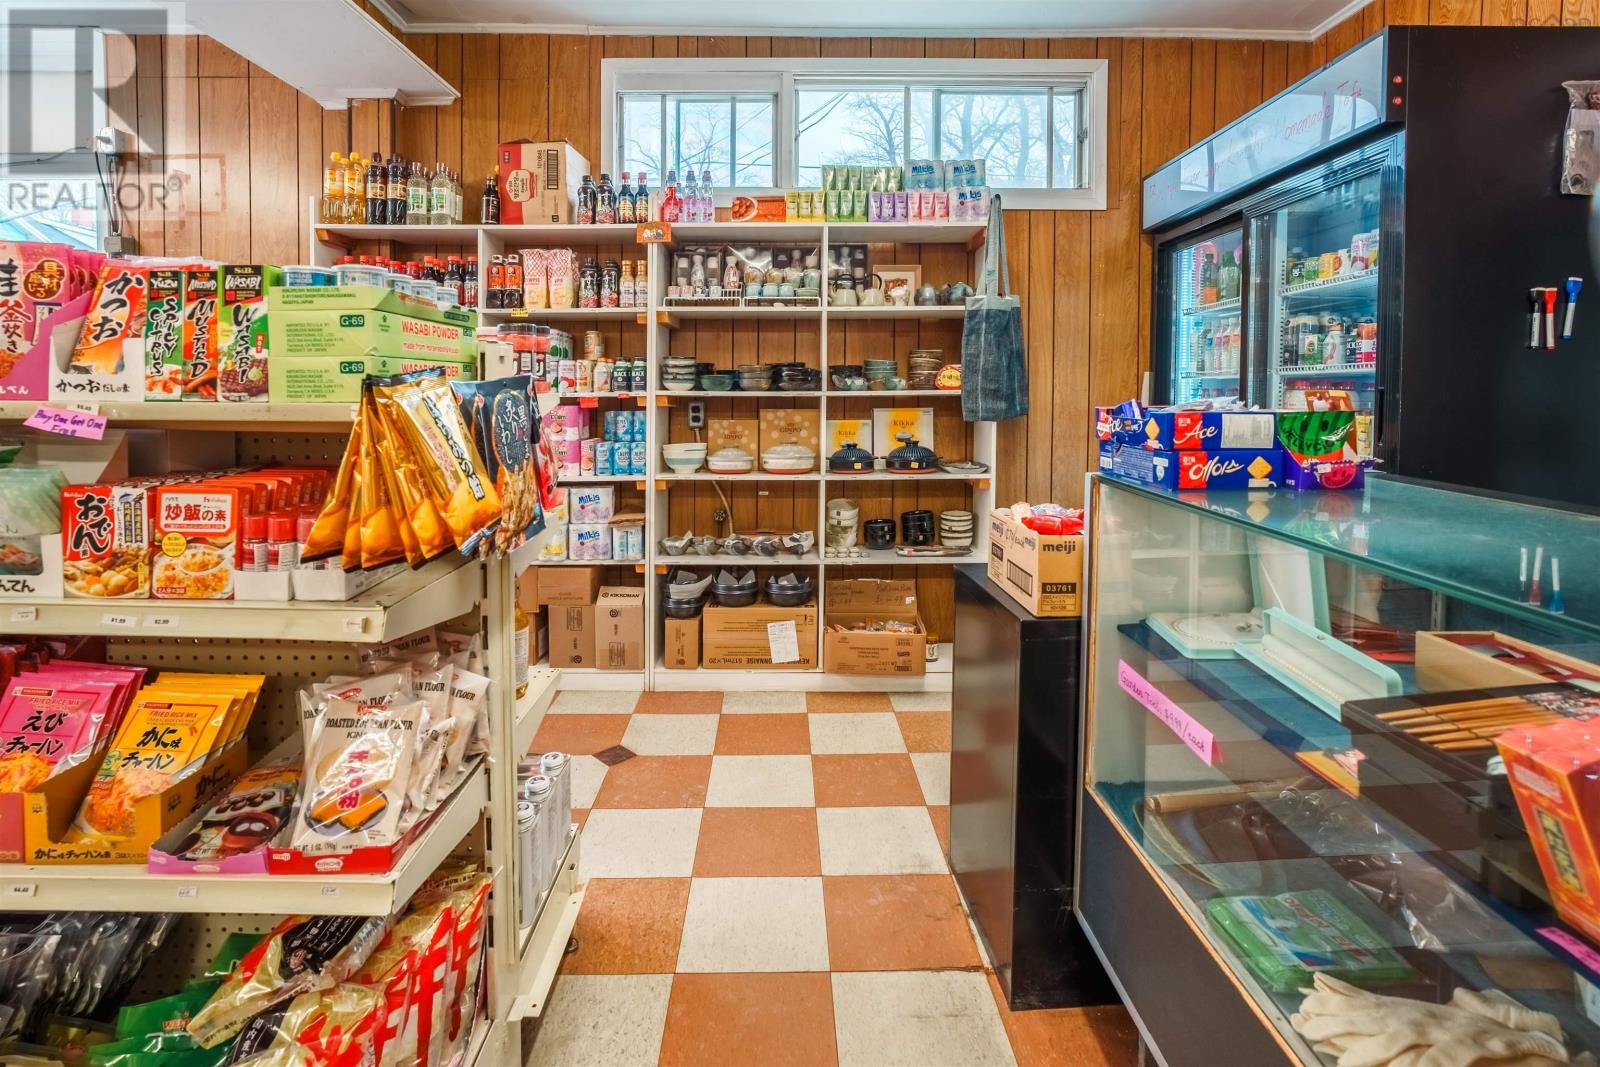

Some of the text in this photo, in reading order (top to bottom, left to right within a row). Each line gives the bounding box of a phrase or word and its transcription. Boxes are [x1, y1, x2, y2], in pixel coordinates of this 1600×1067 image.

[959, 190, 982, 200] Mikis
[225, 274, 261, 289] WASABI
[341, 316, 364, 326] G-69
[402, 320, 460, 340] WASABI POWDER
[187, 299, 215, 378] MUSTARD
[233, 304, 258, 383] WASABI
[341, 363, 364, 372] G-69
[56, 378, 101, 394] かつお
[1173, 420, 1218, 444] Ace
[578, 494, 601, 505] Milkis
[73, 493, 111, 553] おでん
[577, 530, 601, 541] Milkis
[1042, 540, 1076, 554] meiji
[1046, 584, 1073, 593] 03761
[424, 681, 445, 692] FLOUR
[455, 688, 476, 701] FLOUR
[22, 710, 68, 732] えび
[325, 718, 355, 728] ROASTED
[5, 735, 64, 756] チャーハン
[120, 751, 175, 770] チャーハン
